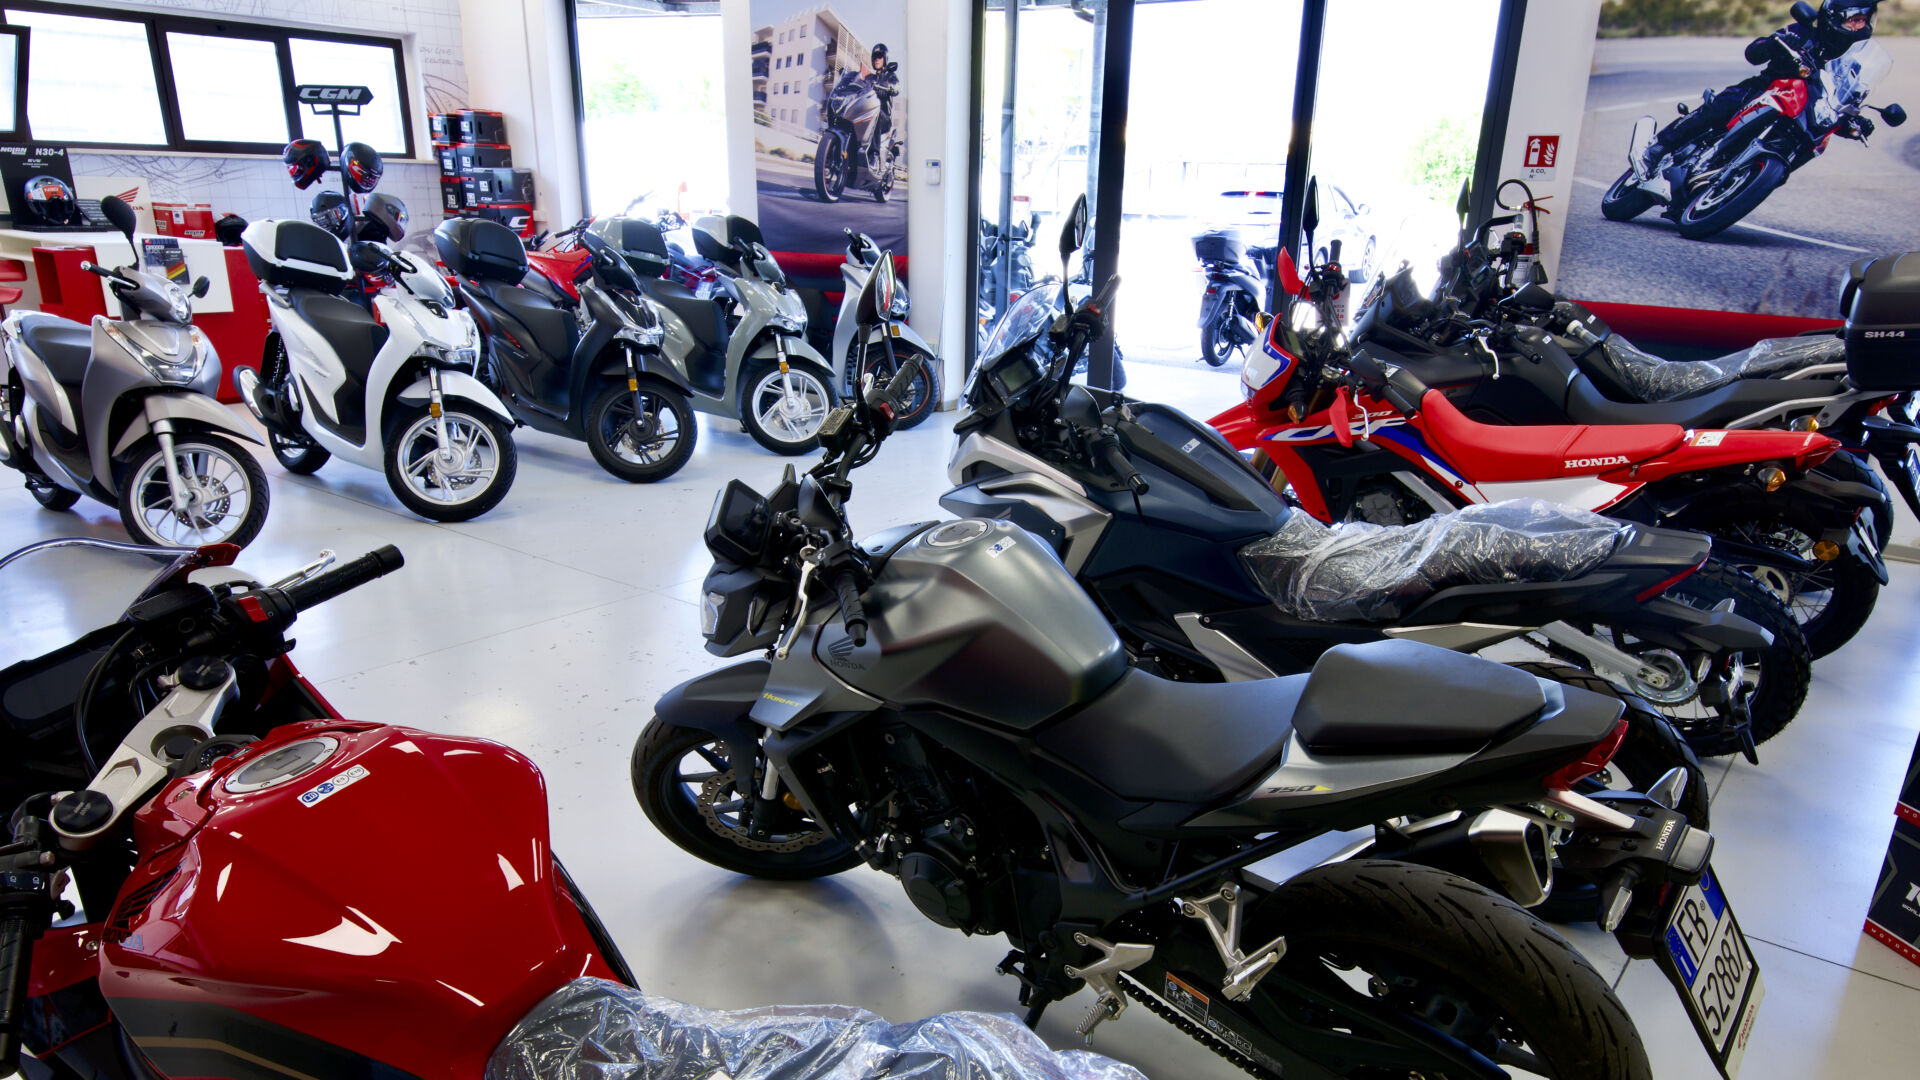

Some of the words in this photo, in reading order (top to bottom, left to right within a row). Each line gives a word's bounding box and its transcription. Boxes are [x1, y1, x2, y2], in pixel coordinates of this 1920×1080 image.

[299, 87, 362, 100] CGM
[0, 147, 27, 155] NOLAN
[35, 148, 64, 156] N30-4
[1564, 455, 1630, 469] HONDA
[830, 658, 868, 671] HONDA
[1267, 784, 1317, 794] 750
[1655, 819, 1676, 851] HONDA
[1676, 898, 1709, 964] FB
[1699, 919, 1745, 1037] 52887
